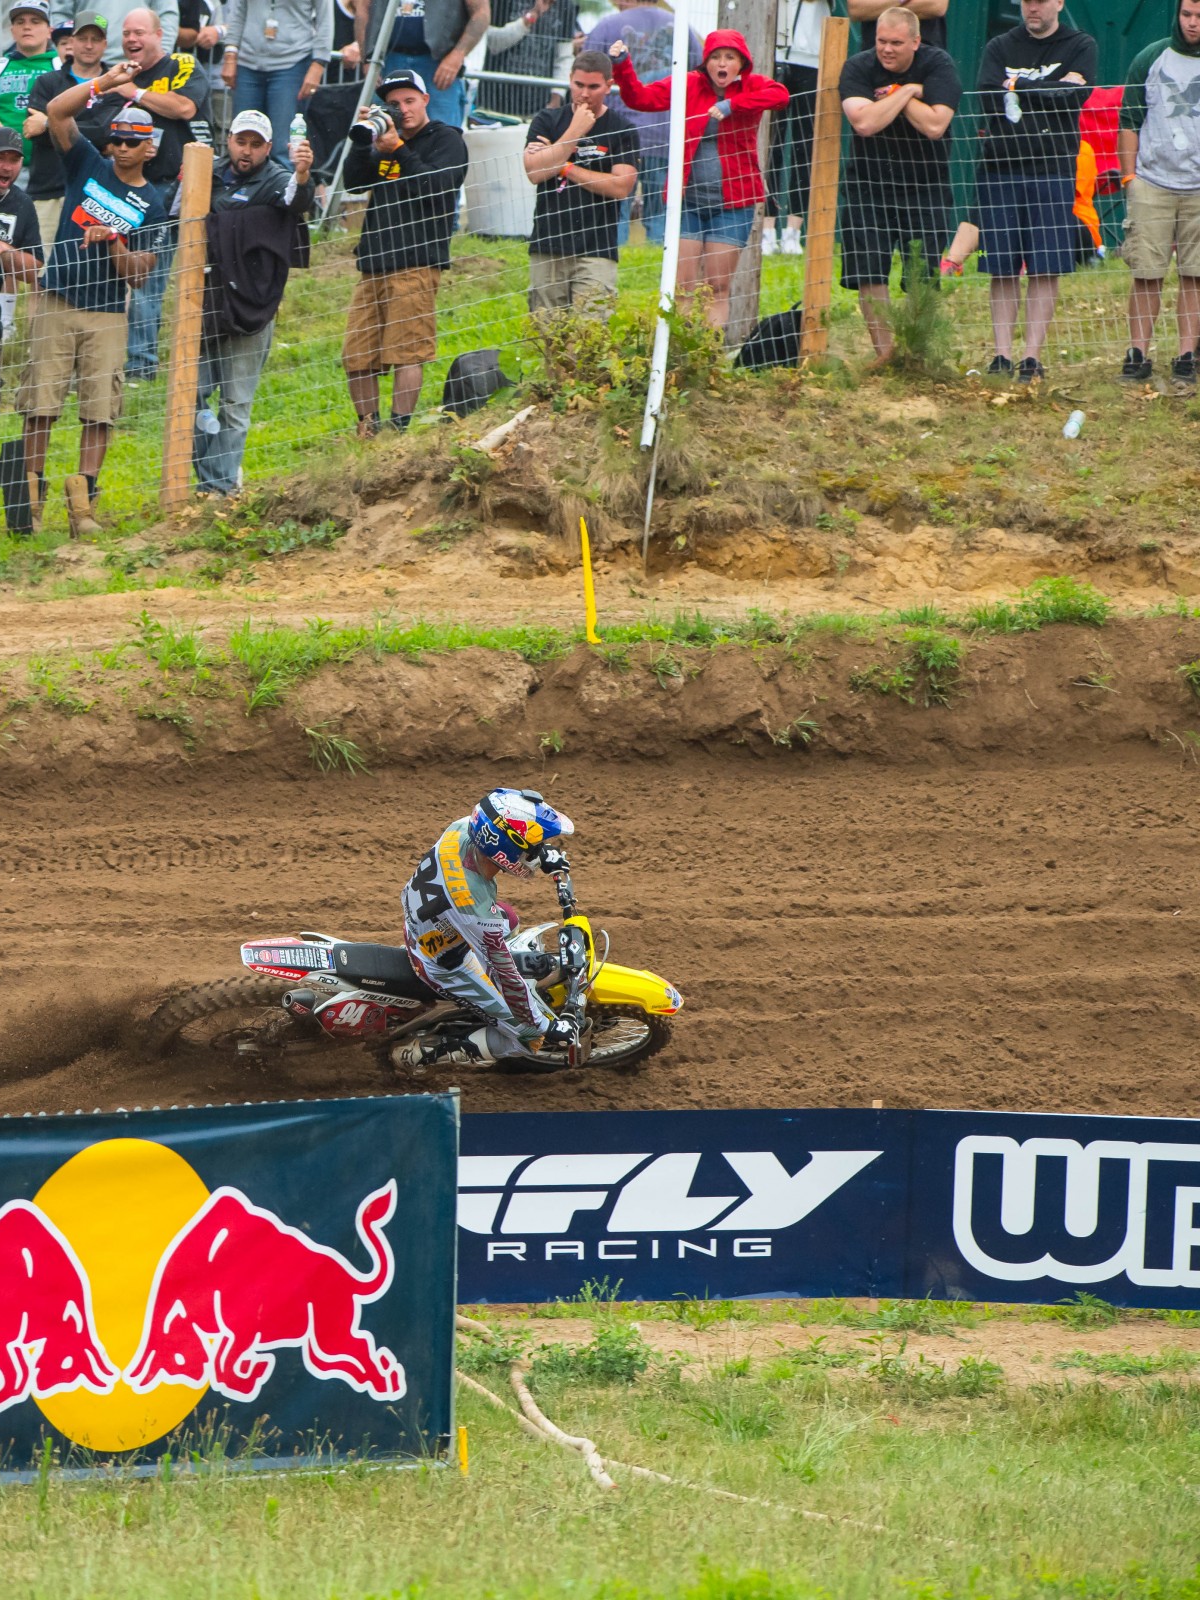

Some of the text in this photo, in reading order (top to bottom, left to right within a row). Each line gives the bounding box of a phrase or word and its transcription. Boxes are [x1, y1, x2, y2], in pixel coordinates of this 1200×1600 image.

[81, 197, 116, 224] LUCAS
[111, 217, 133, 235] OIL
[439, 830, 475, 907] ROCZEN
[492, 851, 517, 871] Red
[410, 846, 452, 923] 94
[254, 965, 302, 979] DUNLOP
[332, 1002, 370, 1027] 94
[495, 1150, 885, 1234] FLY
[486, 1237, 773, 1263] RACING
